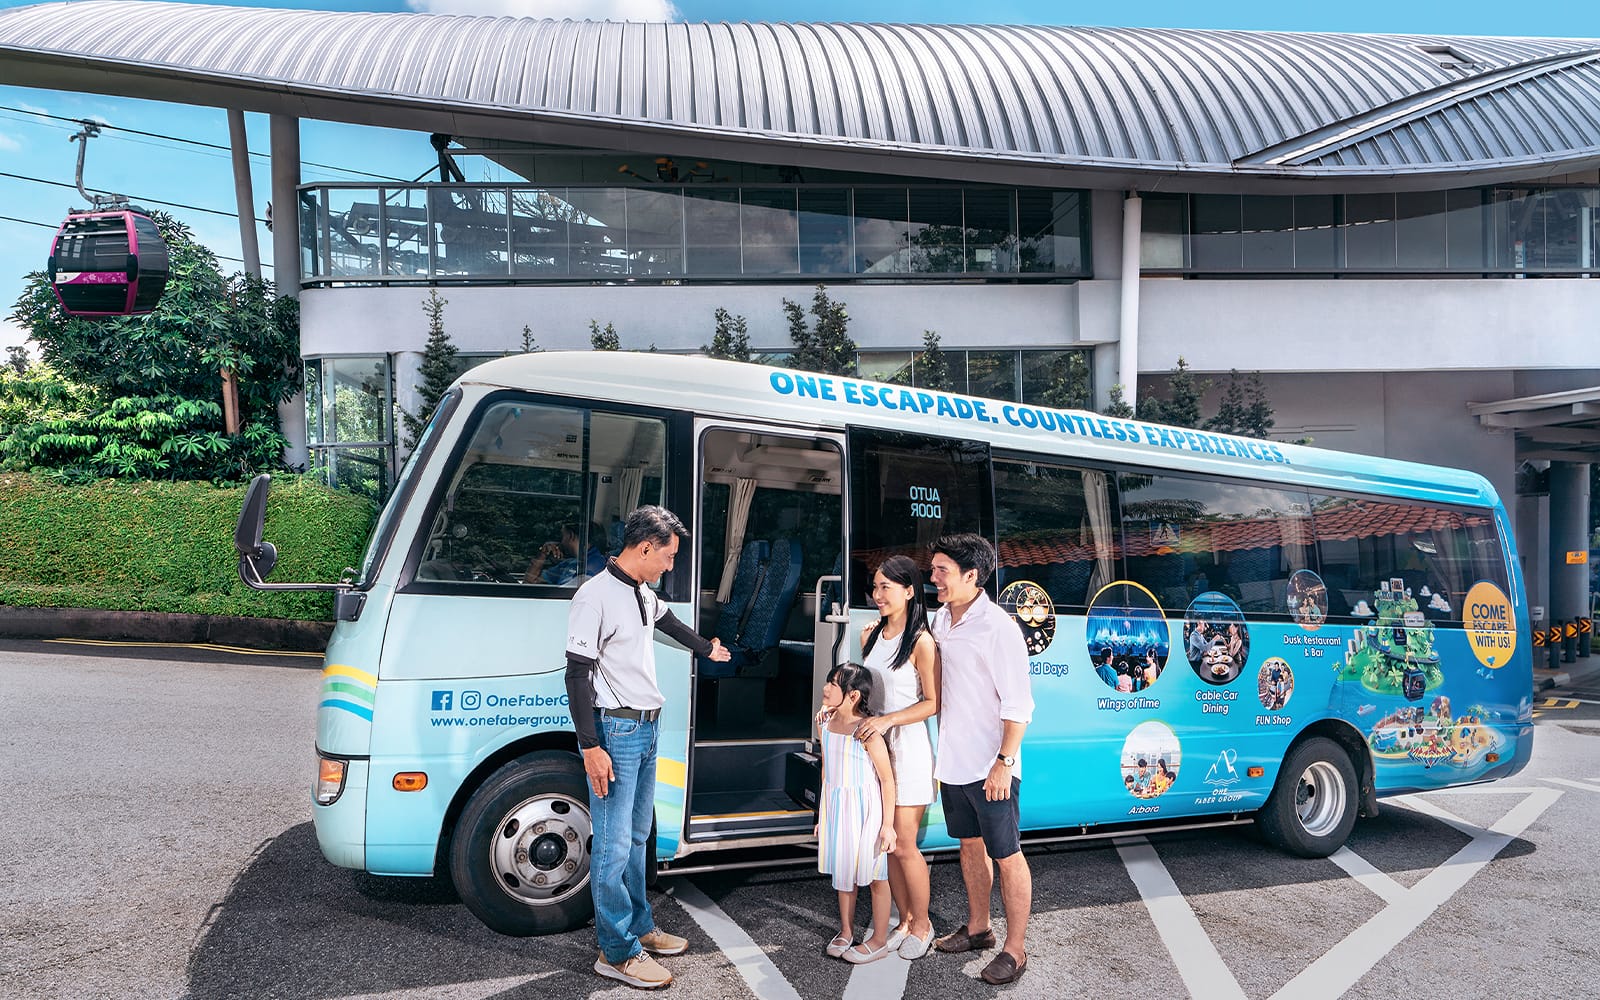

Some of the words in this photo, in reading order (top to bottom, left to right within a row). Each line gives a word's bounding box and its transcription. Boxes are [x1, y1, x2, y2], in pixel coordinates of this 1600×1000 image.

[770, 371, 836, 401] ONE
[843, 381, 998, 424] ESCAPADE.
[1002, 405, 1140, 443] COUNTLESS
[1142, 425, 1291, 465] EXPERIENCES.
[1471, 603, 1506, 620] COME
[1473, 621, 1509, 634] ESCAPE
[1283, 635, 1302, 645] Dusk
[1303, 636, 1341, 646] Restaurant
[1475, 635, 1496, 648] WITH
[1497, 636, 1511, 648] US!
[1311, 648, 1324, 657] Bar
[1029, 661, 1041, 675] ld
[1043, 661, 1069, 677] Days
[487, 693, 569, 707] OneFaberG
[1195, 690, 1221, 701] Cable
[1222, 690, 1239, 701] Car
[1097, 698, 1126, 711] Wings
[1127, 697, 1137, 709] of
[1138, 697, 1160, 709] Time
[1202, 703, 1229, 715] Dining
[431, 714, 571, 728] www.onefabergroup.
[1256, 715, 1270, 725] FUN
[1272, 715, 1292, 726] Shop
[1212, 788, 1228, 796] ONE
